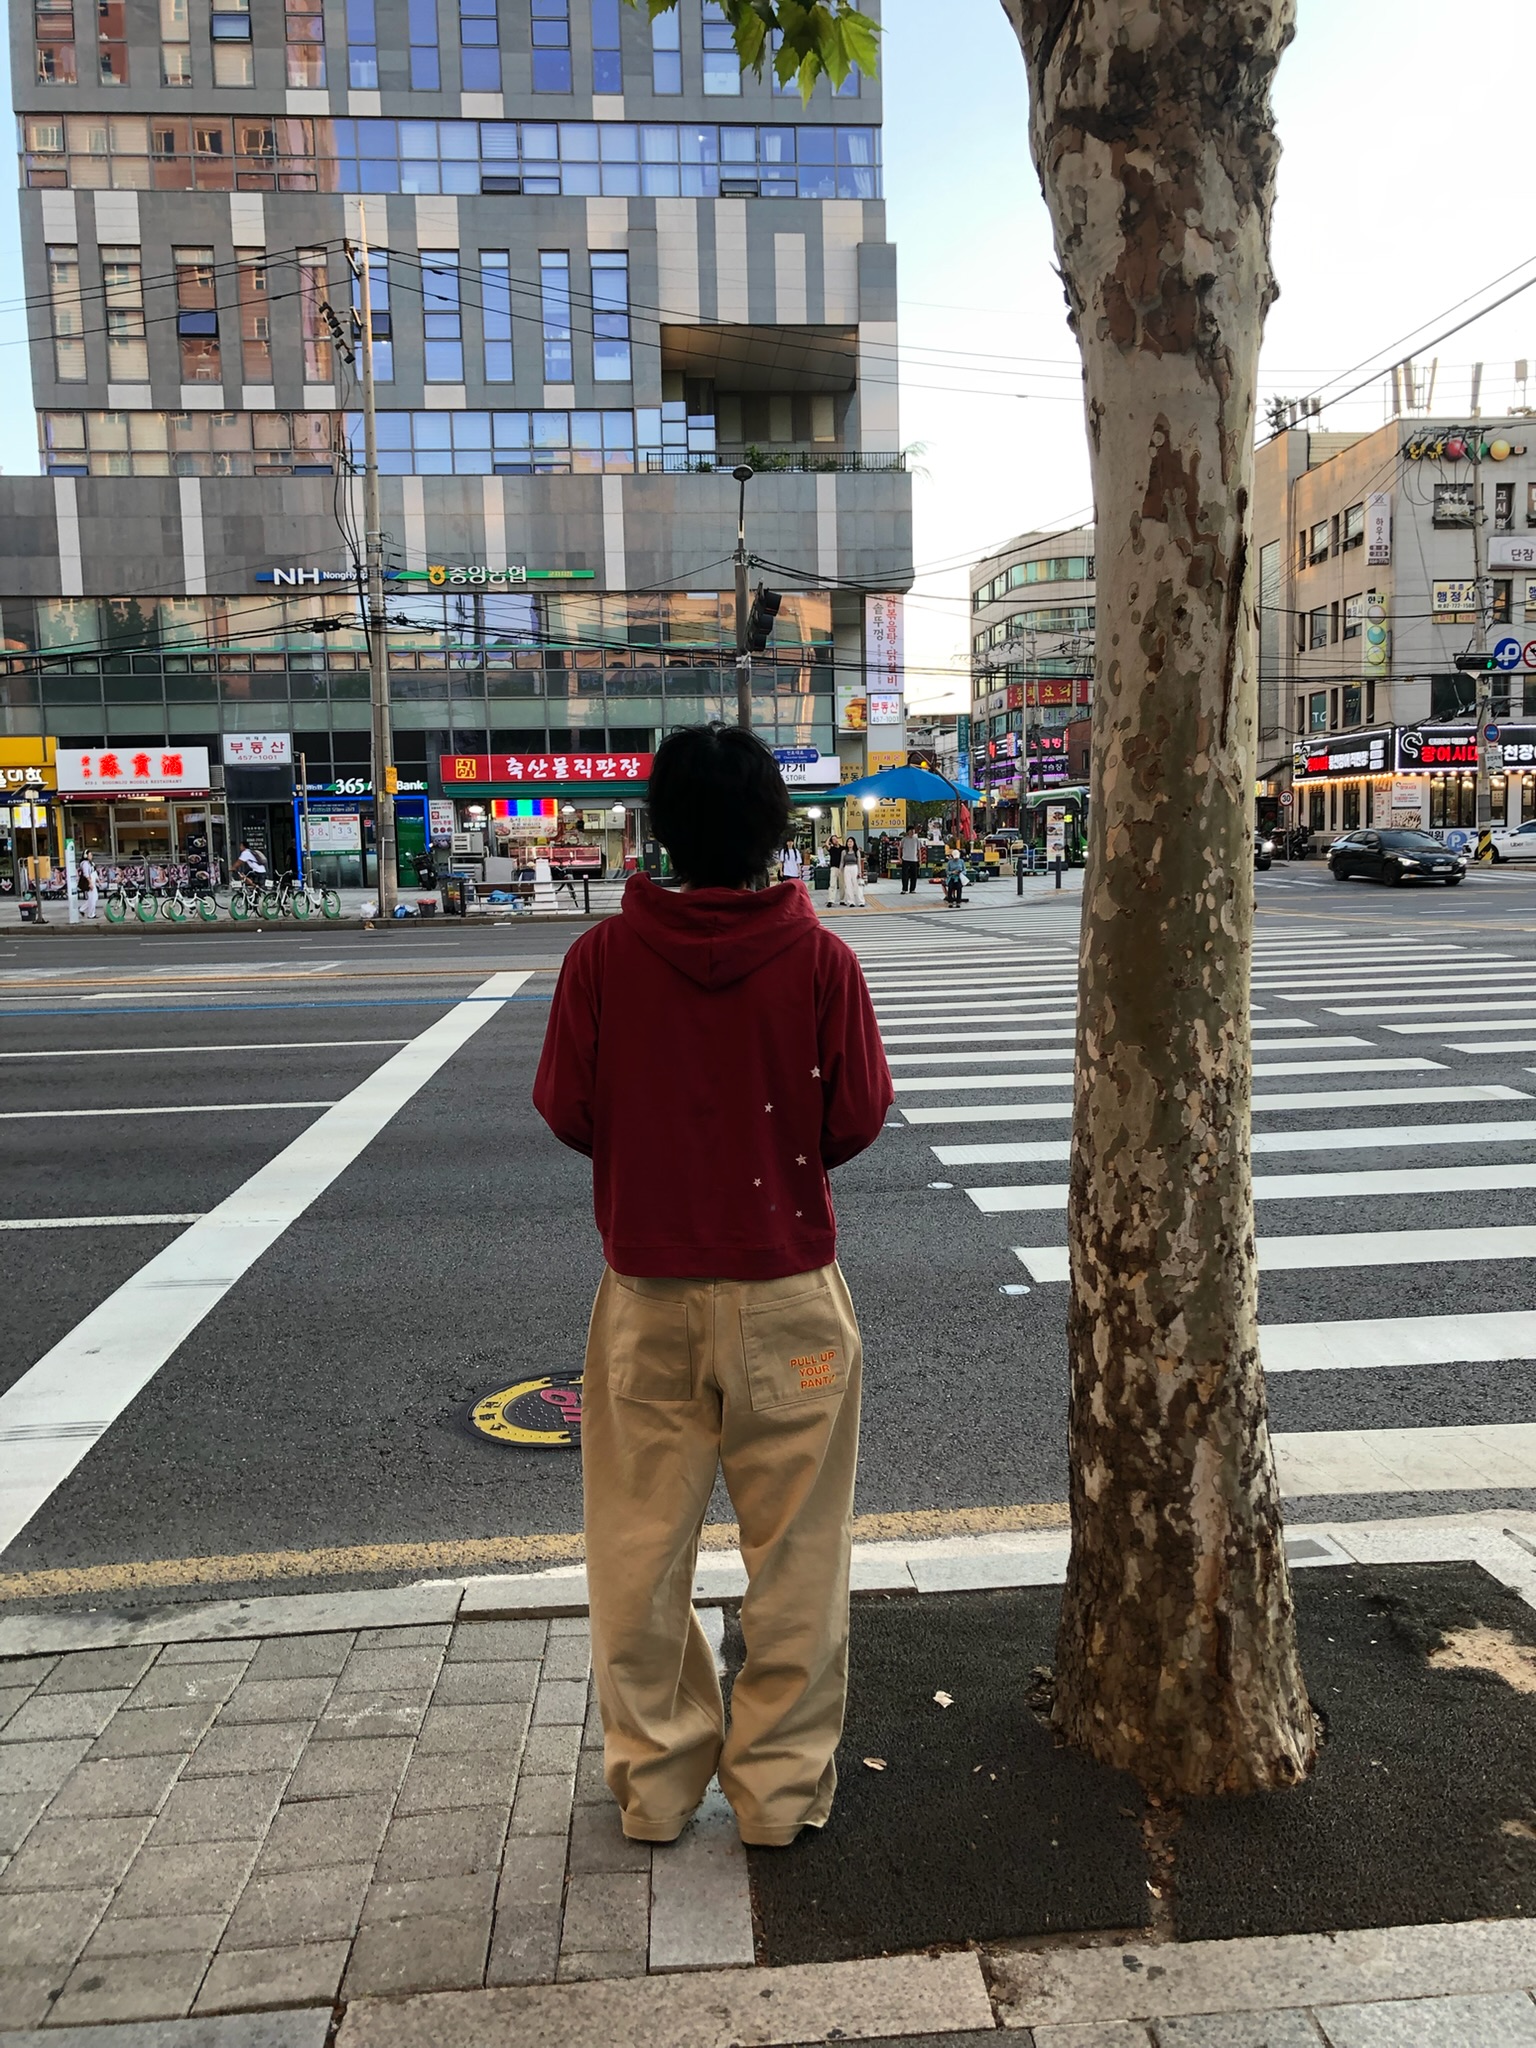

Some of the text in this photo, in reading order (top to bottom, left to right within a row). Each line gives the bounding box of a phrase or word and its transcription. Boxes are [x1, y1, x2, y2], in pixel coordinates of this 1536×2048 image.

[1496, 489, 1507, 529] 고시원
[273, 567, 368, 586] NH NongHyp
[448, 566, 527, 585] 중앙농협
[872, 602, 884, 641] 솥뚜껑
[872, 701, 899, 715] 부동산
[230, 742, 285, 754] 부동산
[505, 757, 641, 779] 축산물직판장
[335, 778, 365, 795] 365
[397, 780, 425, 791] Bank
[785, 774, 807, 782] STORE
[1281, 795, 1291, 803] 30
[790, 1351, 836, 1368] PULL UP
[799, 1365, 830, 1377] YOUR
